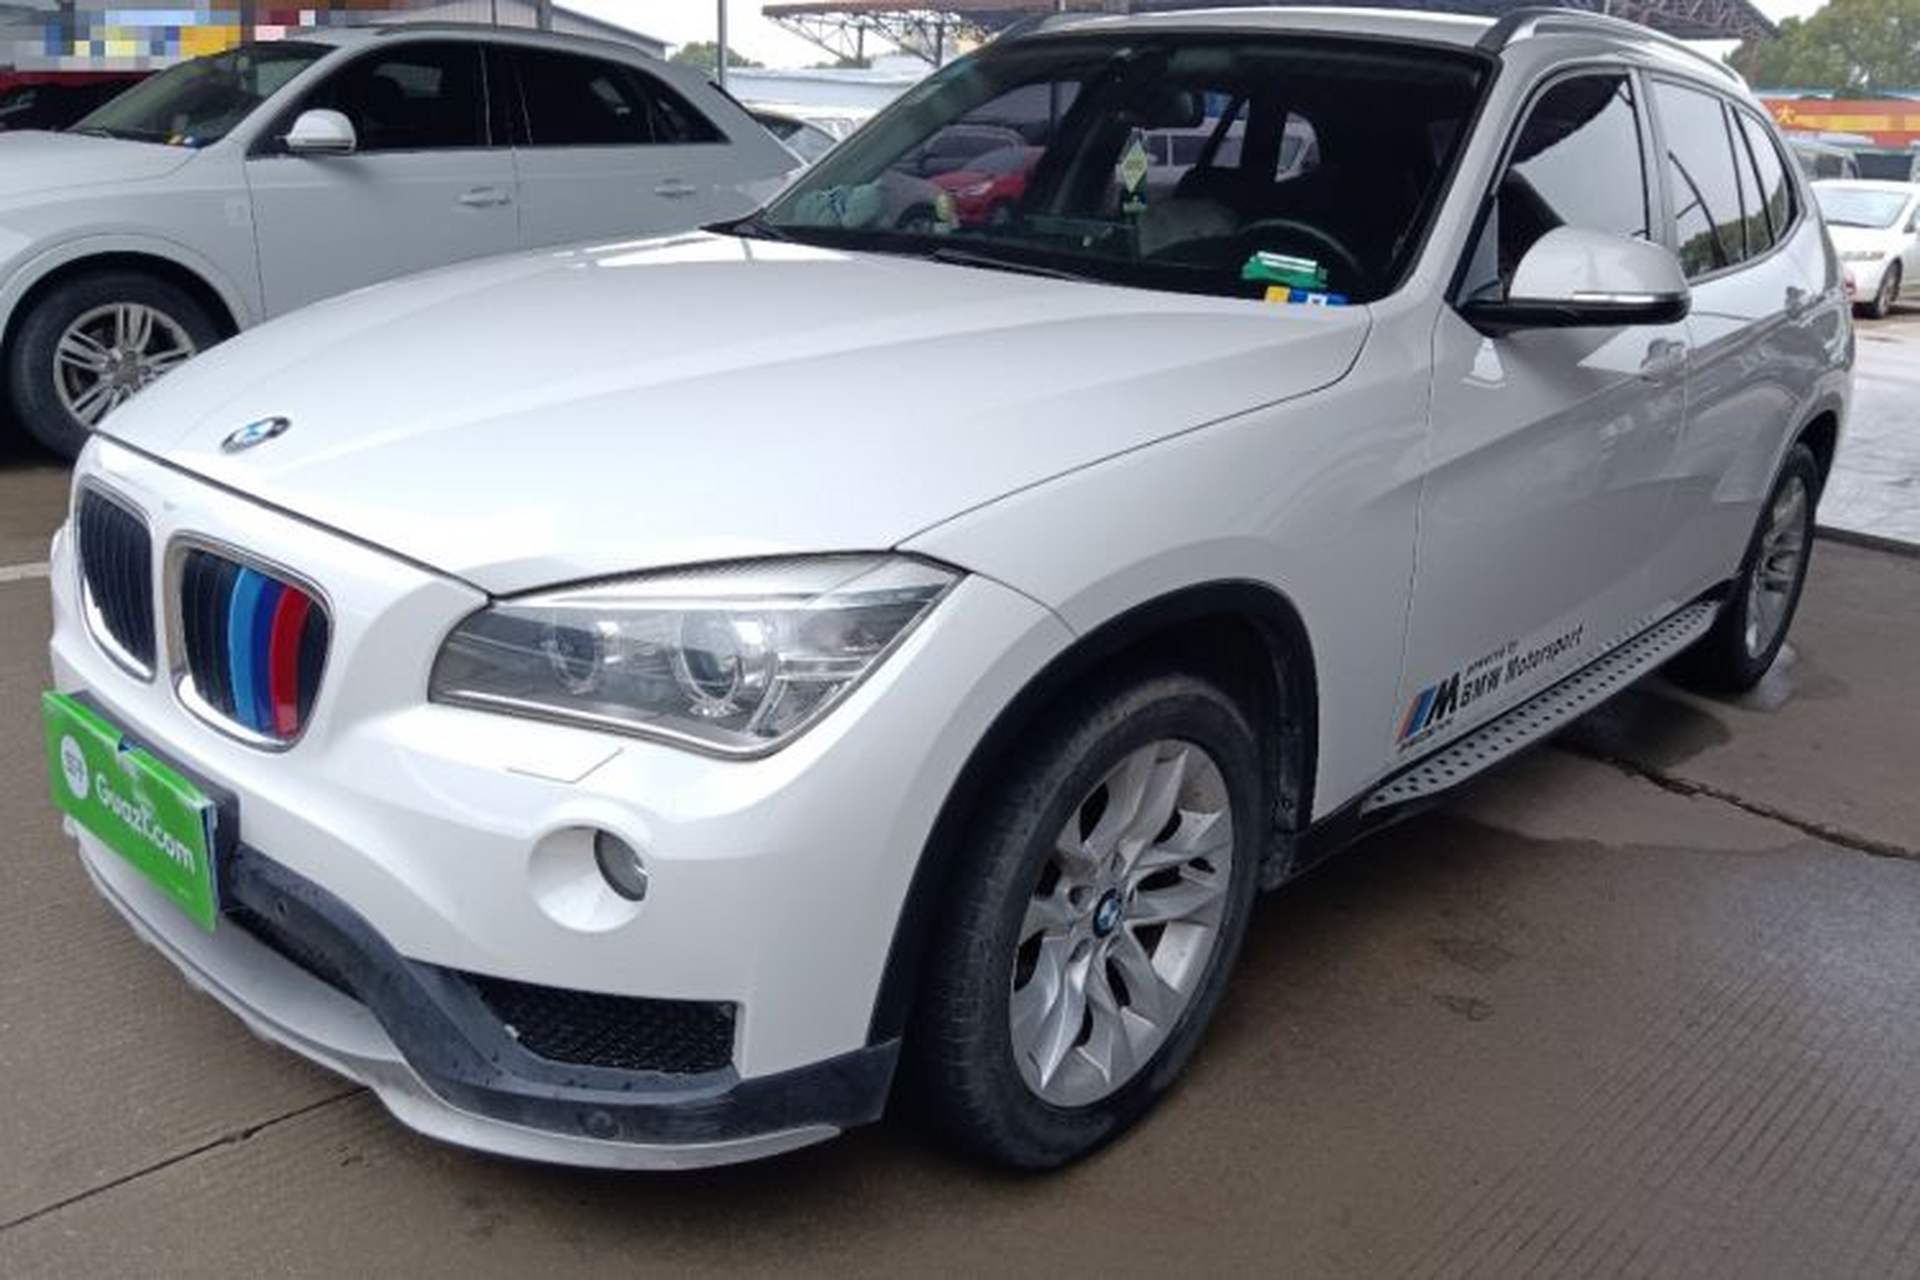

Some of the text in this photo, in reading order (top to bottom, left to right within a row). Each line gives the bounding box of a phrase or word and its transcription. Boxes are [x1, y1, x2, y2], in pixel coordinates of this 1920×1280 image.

[1459, 622, 1584, 708] BMW Motorsport
[95, 772, 196, 876] Guazi.com
